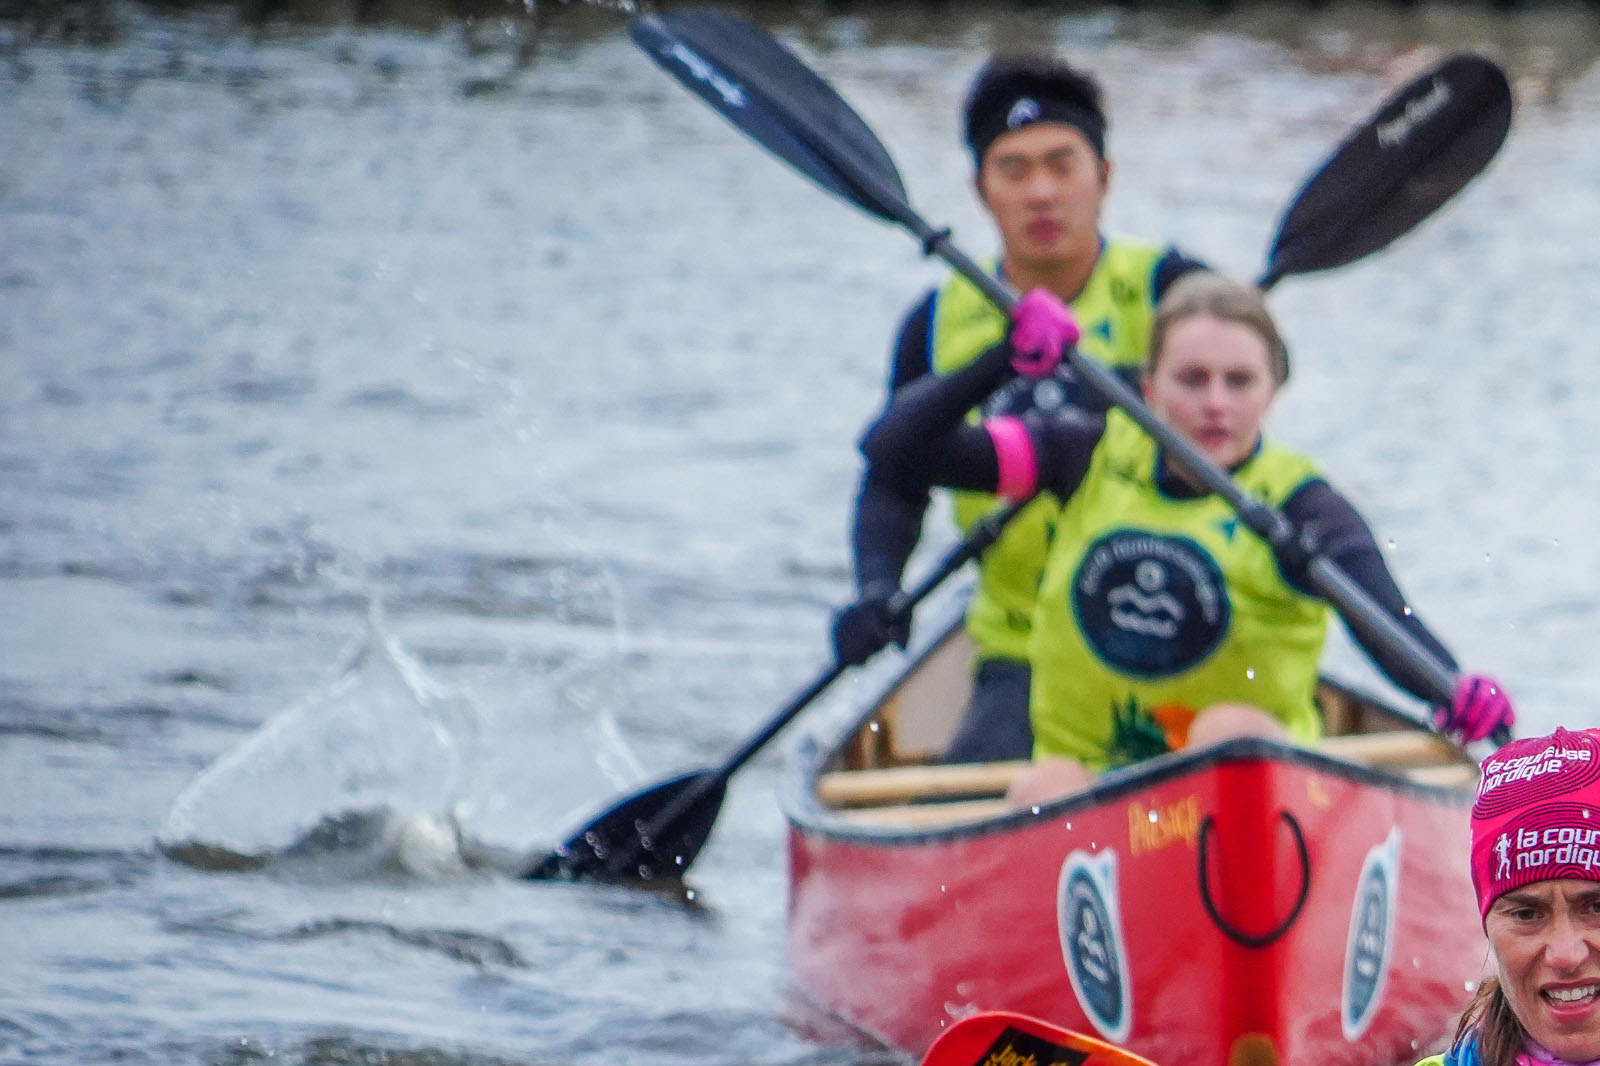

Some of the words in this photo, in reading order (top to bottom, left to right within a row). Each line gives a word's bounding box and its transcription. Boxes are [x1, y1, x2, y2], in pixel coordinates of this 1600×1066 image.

[1486, 760, 1504, 776] la
[1503, 746, 1592, 771] coureuse
[1482, 760, 1563, 795] nordique
[1516, 828, 1539, 849] la
